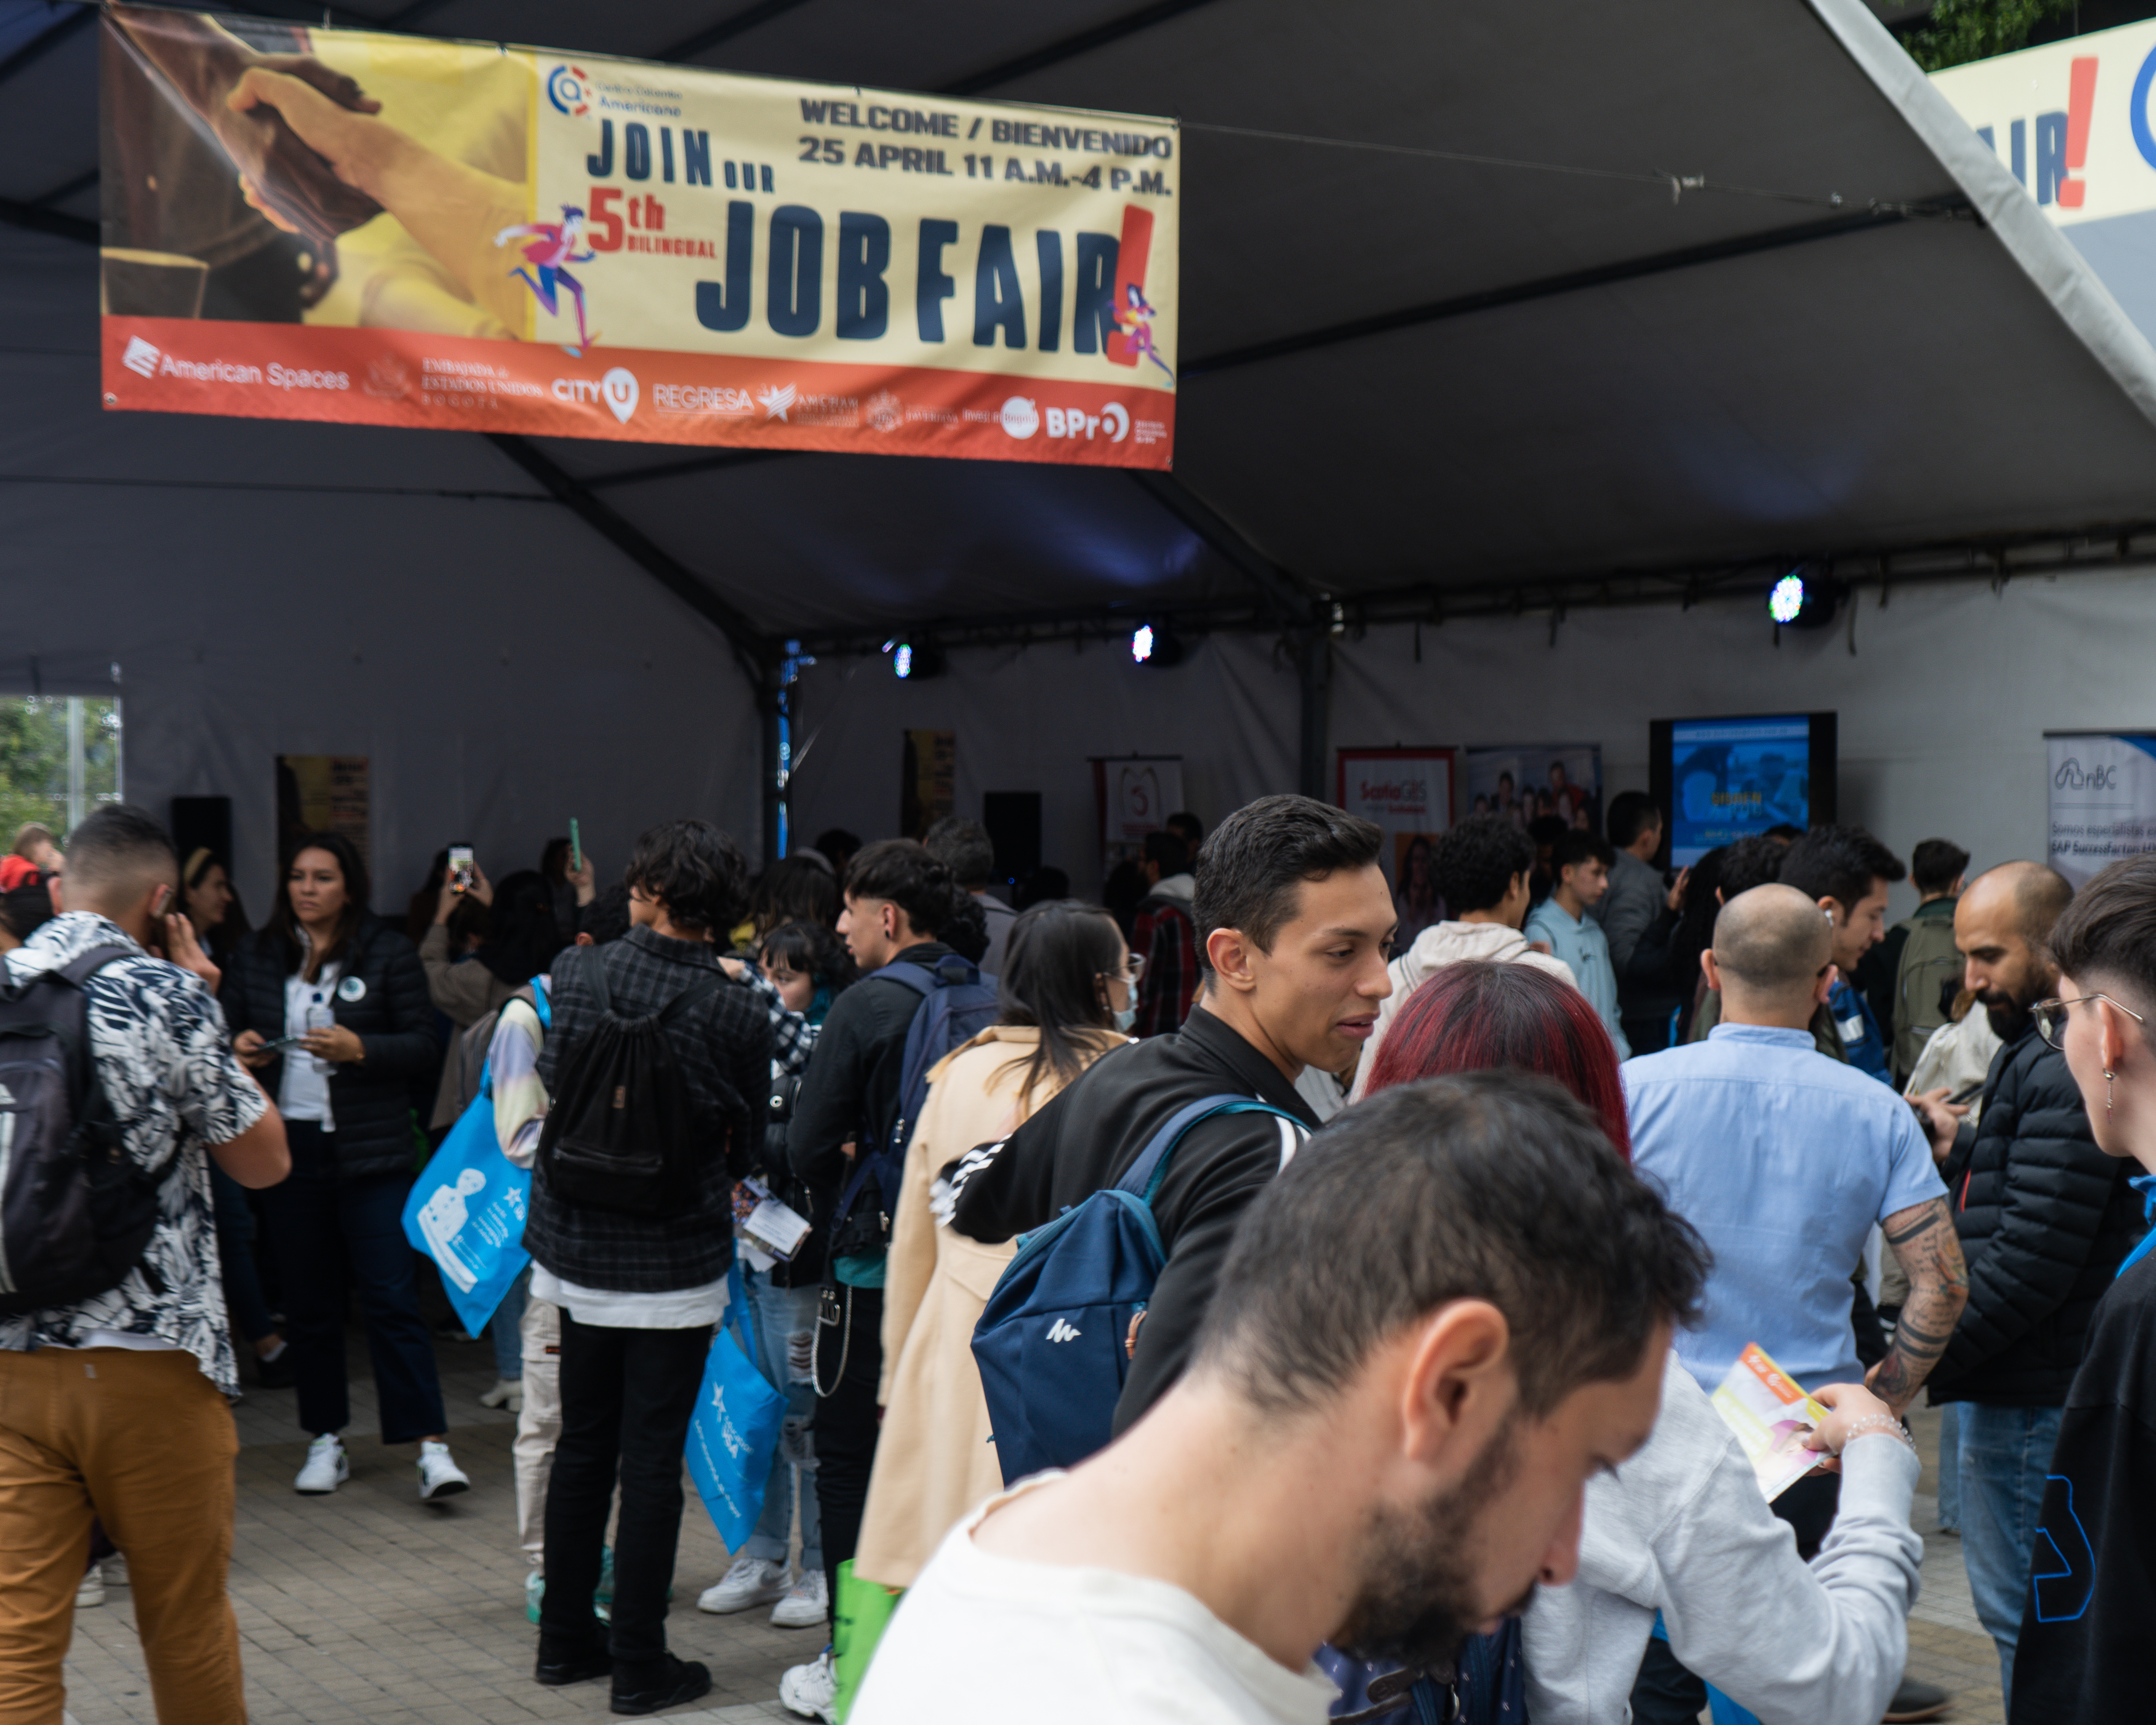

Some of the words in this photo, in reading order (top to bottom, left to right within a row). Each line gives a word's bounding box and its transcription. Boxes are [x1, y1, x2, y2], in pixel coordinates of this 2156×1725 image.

[599, 95, 682, 118] Americano
[800, 98, 959, 138] WELCOME
[968, 118, 982, 140] /
[992, 119, 1172, 160] BIENVENIDO
[587, 119, 711, 186] JOIN
[725, 161, 774, 193] OUR
[799, 138, 845, 166] 25
[855, 143, 953, 176] APRIL
[964, 154, 993, 180] 11
[1110, 165, 1172, 197] P.M.
[588, 187, 665, 252] 5th
[627, 233, 717, 259] BILINGUAL
[695, 201, 892, 341] JOB
[160, 354, 261, 384] American
[266, 362, 349, 391] Spaces
[422, 357, 495, 377] EMBAJADA
[422, 374, 487, 393] ESTADOS
[488, 380, 543, 398] UNIDOS
[653, 383, 755, 411] REGRESA
[962, 408, 991, 423] Invest
[2052, 820, 2084, 835] Somos
[2087, 821, 2144, 838] especialistas
